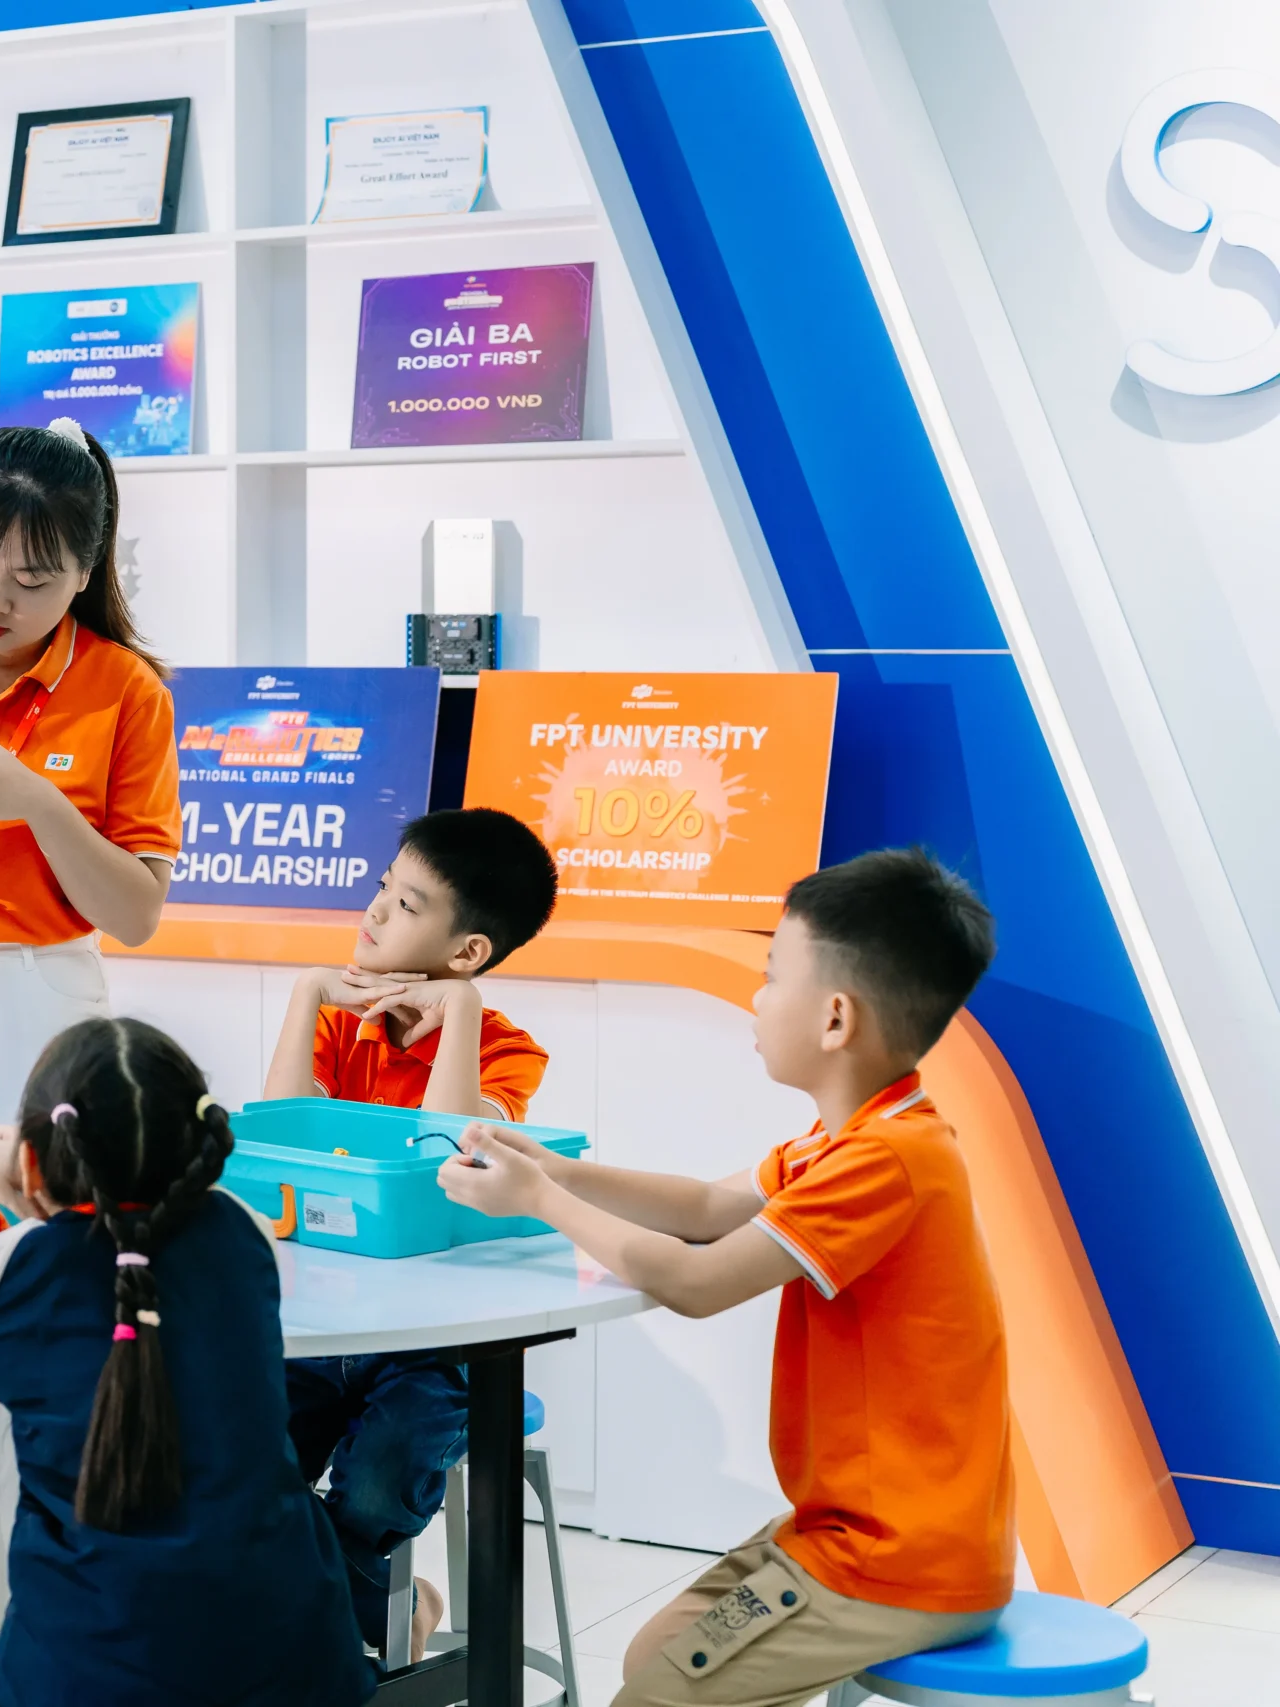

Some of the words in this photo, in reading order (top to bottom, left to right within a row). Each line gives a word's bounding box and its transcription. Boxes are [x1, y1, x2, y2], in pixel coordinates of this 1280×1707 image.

[361, 174, 387, 184] Great
[388, 171, 416, 182] Effort
[419, 169, 448, 180] Award
[410, 321, 475, 349] GIẢI
[488, 323, 534, 345] BA
[27, 346, 89, 364] ROBOTICS
[90, 343, 164, 361] EXCELLENCE
[397, 353, 473, 371] ROBOT
[479, 349, 542, 367] FIRST
[71, 366, 116, 381] AWARD
[387, 396, 490, 414] 1.000.000
[529, 723, 585, 747] FPT
[591, 724, 769, 750] UNIVERSITY
[223, 752, 302, 764] CHALLENGE
[179, 769, 247, 783] NATIONAL
[252, 770, 300, 784] GRAND
[304, 771, 355, 785] FINALS
[604, 759, 683, 778] AWARD
[573, 787, 704, 839] 10%
[556, 848, 711, 870] SCHOLARSHIP
[171, 851, 369, 888] CHOLARSHIP
[686, 892, 729, 902] CHALLENGE
